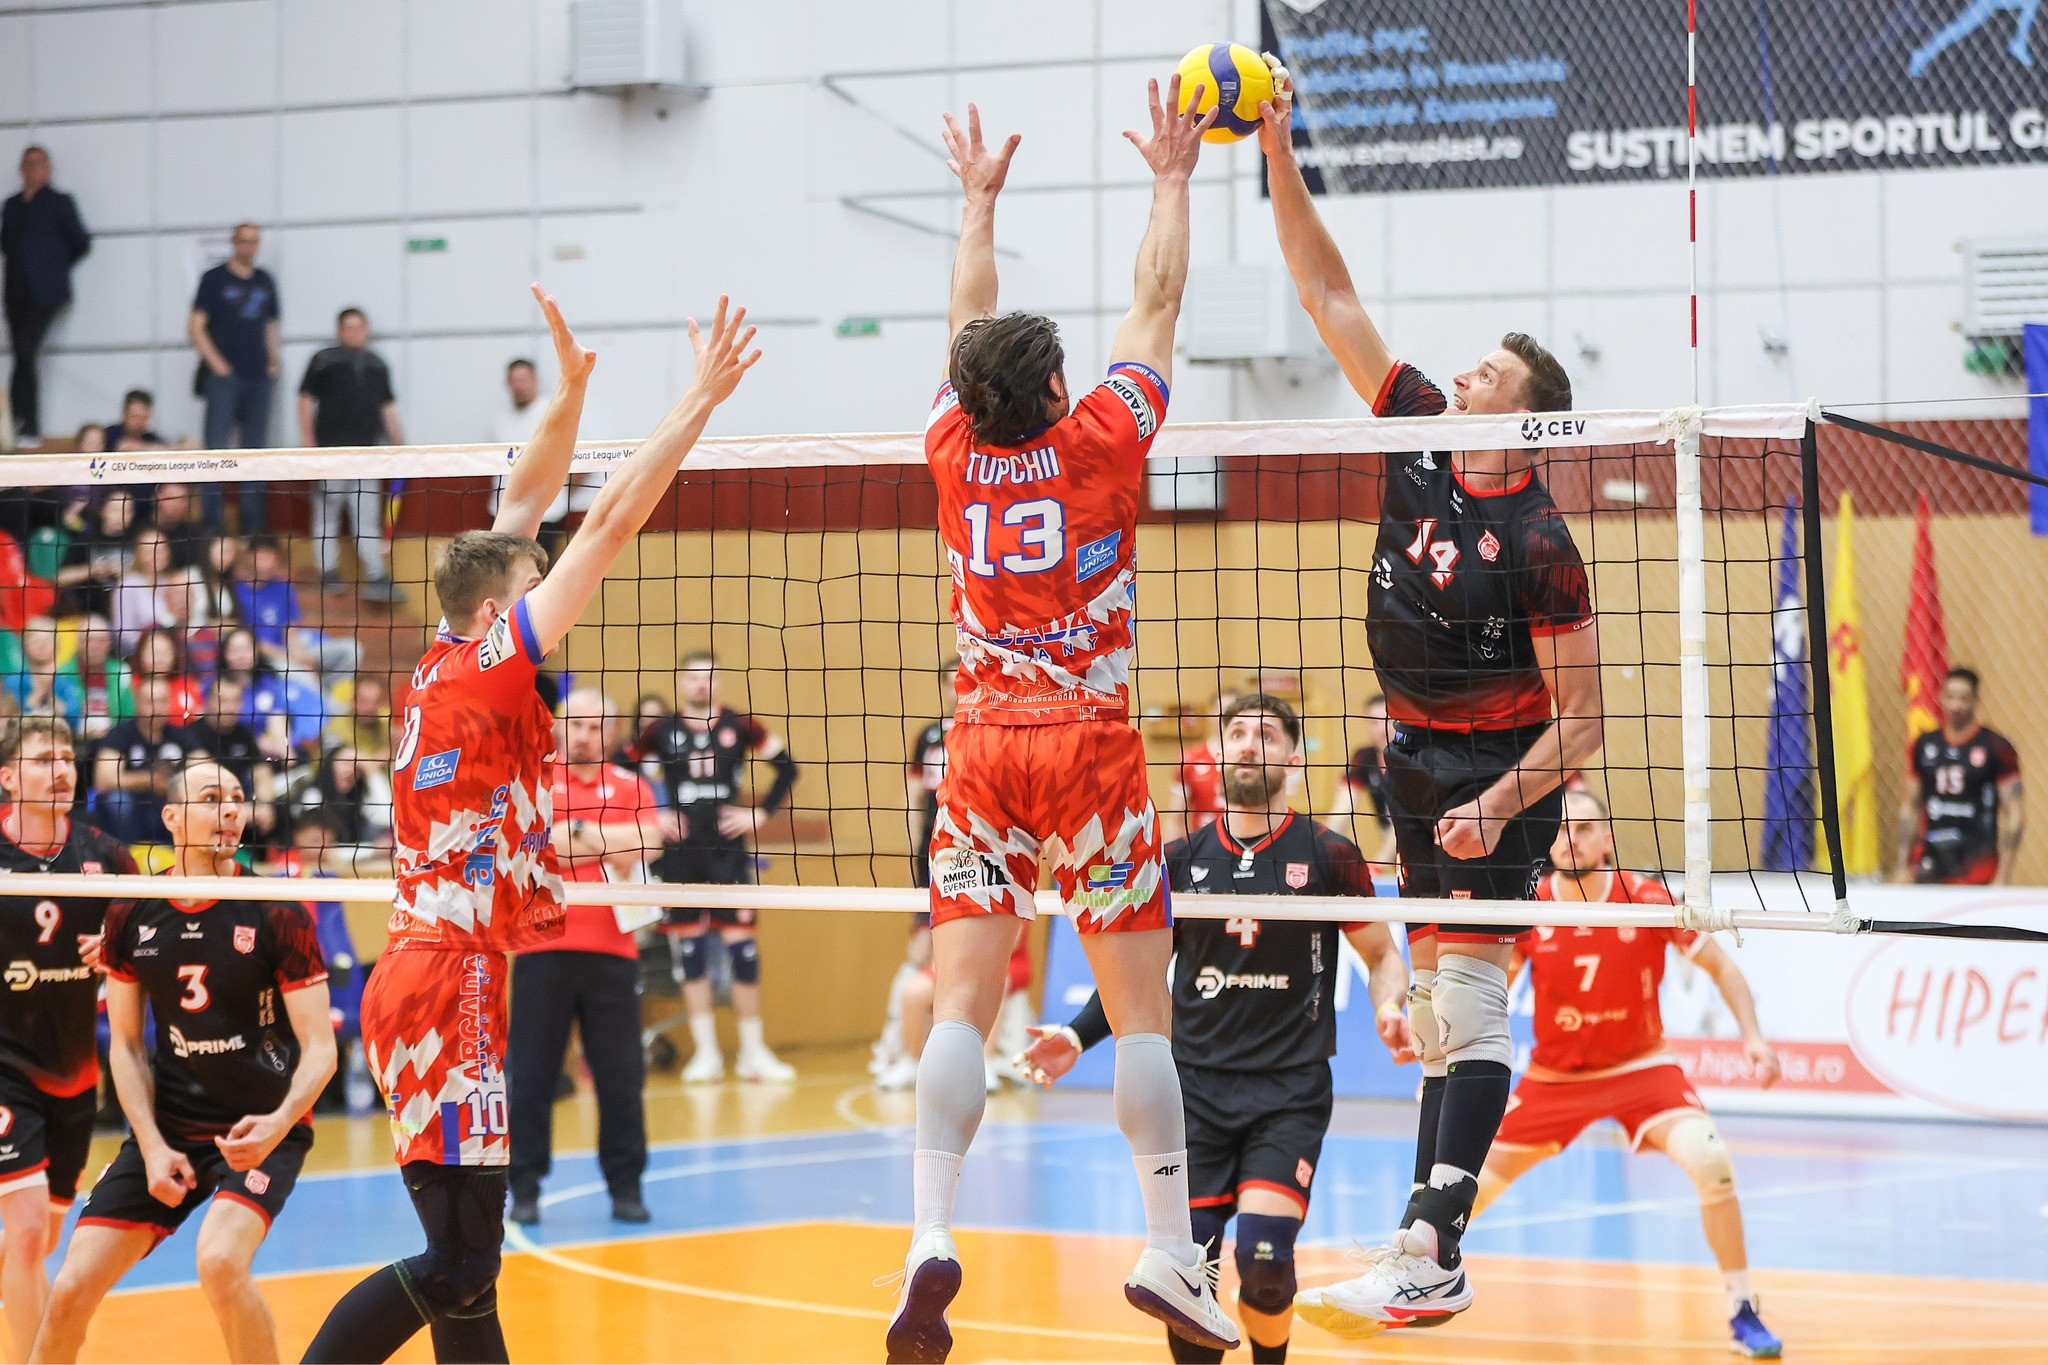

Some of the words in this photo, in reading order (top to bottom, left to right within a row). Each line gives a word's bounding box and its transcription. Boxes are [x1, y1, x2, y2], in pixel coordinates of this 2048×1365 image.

[1794, 110, 2001, 161] SPORTUL
[1547, 420, 1586, 436] CEV
[112, 462, 127, 472] CEV
[128, 461, 167, 473] Champions
[169, 460, 196, 471] League
[220, 459, 238, 469] 2024
[592, 449, 622, 461] League
[966, 446, 1061, 486] TUPCHII
[963, 497, 1066, 578] 13
[1079, 549, 1115, 574] UNIQA
[417, 766, 453, 783] UNIQA
[943, 869, 977, 885] AMIRO
[943, 879, 978, 894] EVENTS
[34, 899, 62, 945] 9
[177, 963, 210, 1013] 3
[1226, 974, 1290, 990] PRIME
[1573, 954, 1602, 993] 7
[1886, 966, 2048, 1047] HIPE
[466, 1091, 509, 1137] 10
